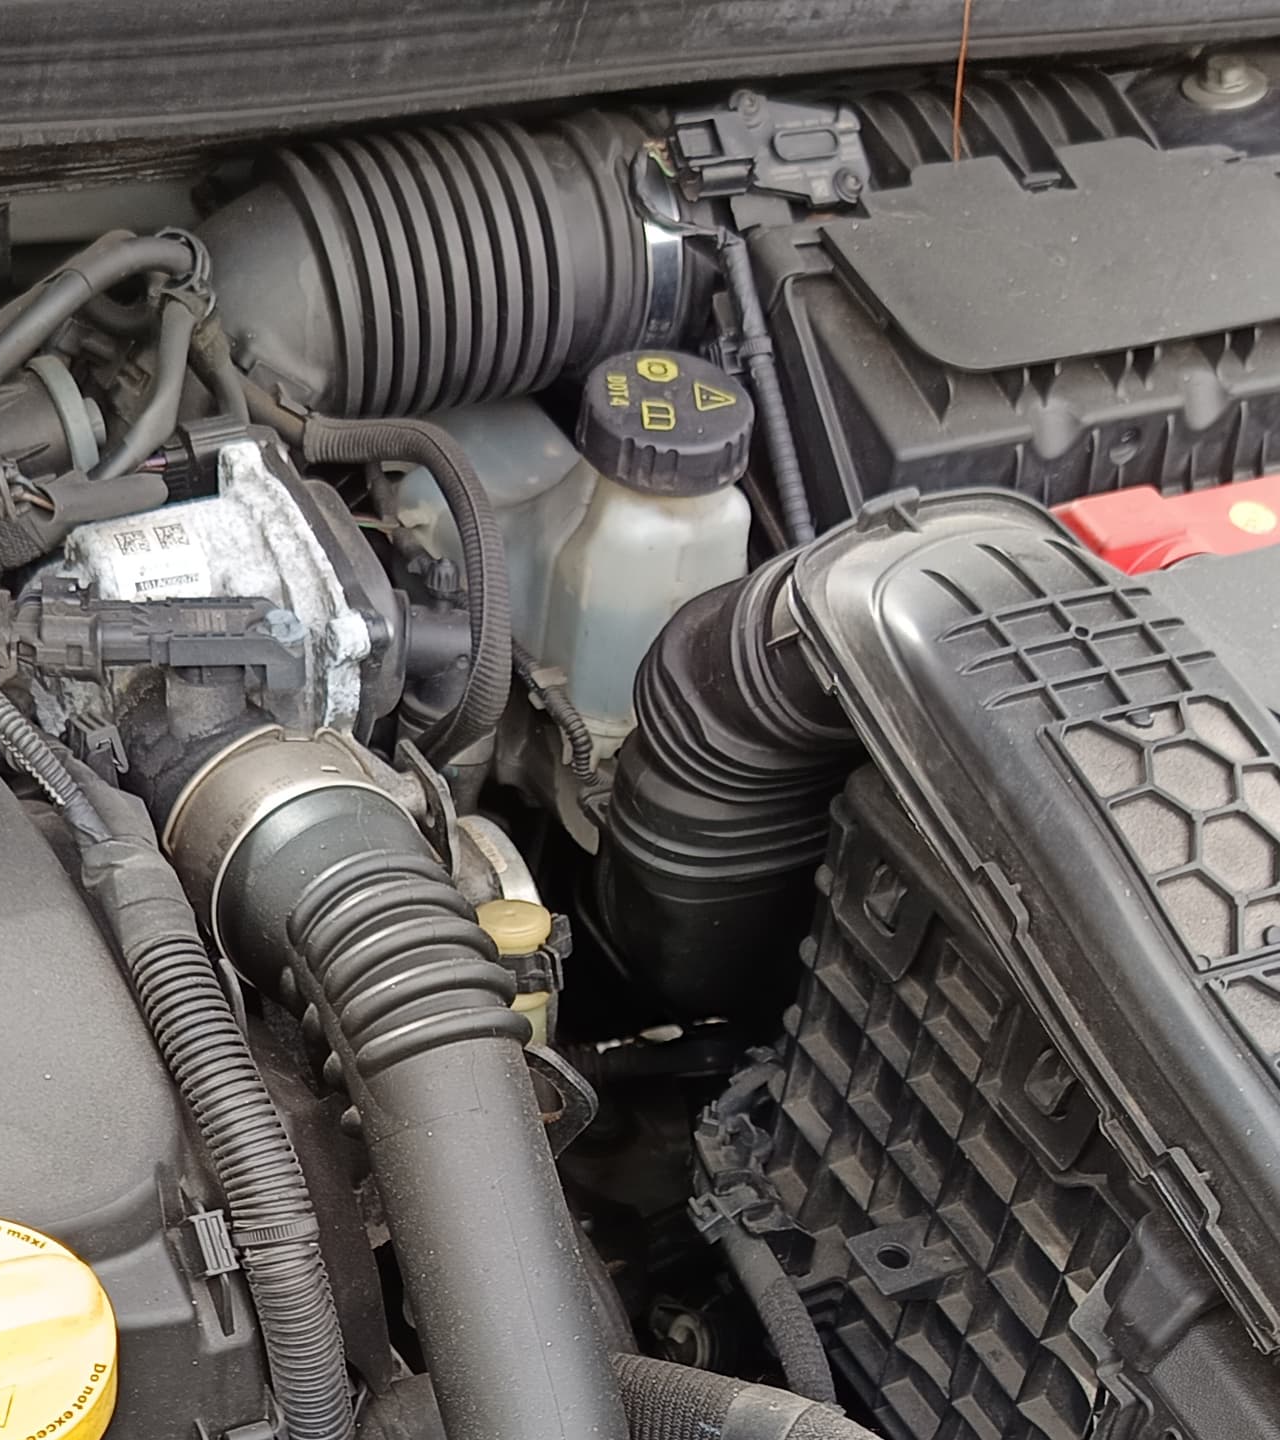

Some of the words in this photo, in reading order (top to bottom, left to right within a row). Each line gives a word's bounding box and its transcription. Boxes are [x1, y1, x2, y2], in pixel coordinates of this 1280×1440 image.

[7, 1228, 47, 1249] maxi
[90, 1363, 107, 1382] Do
[72, 1386, 94, 1410] not
